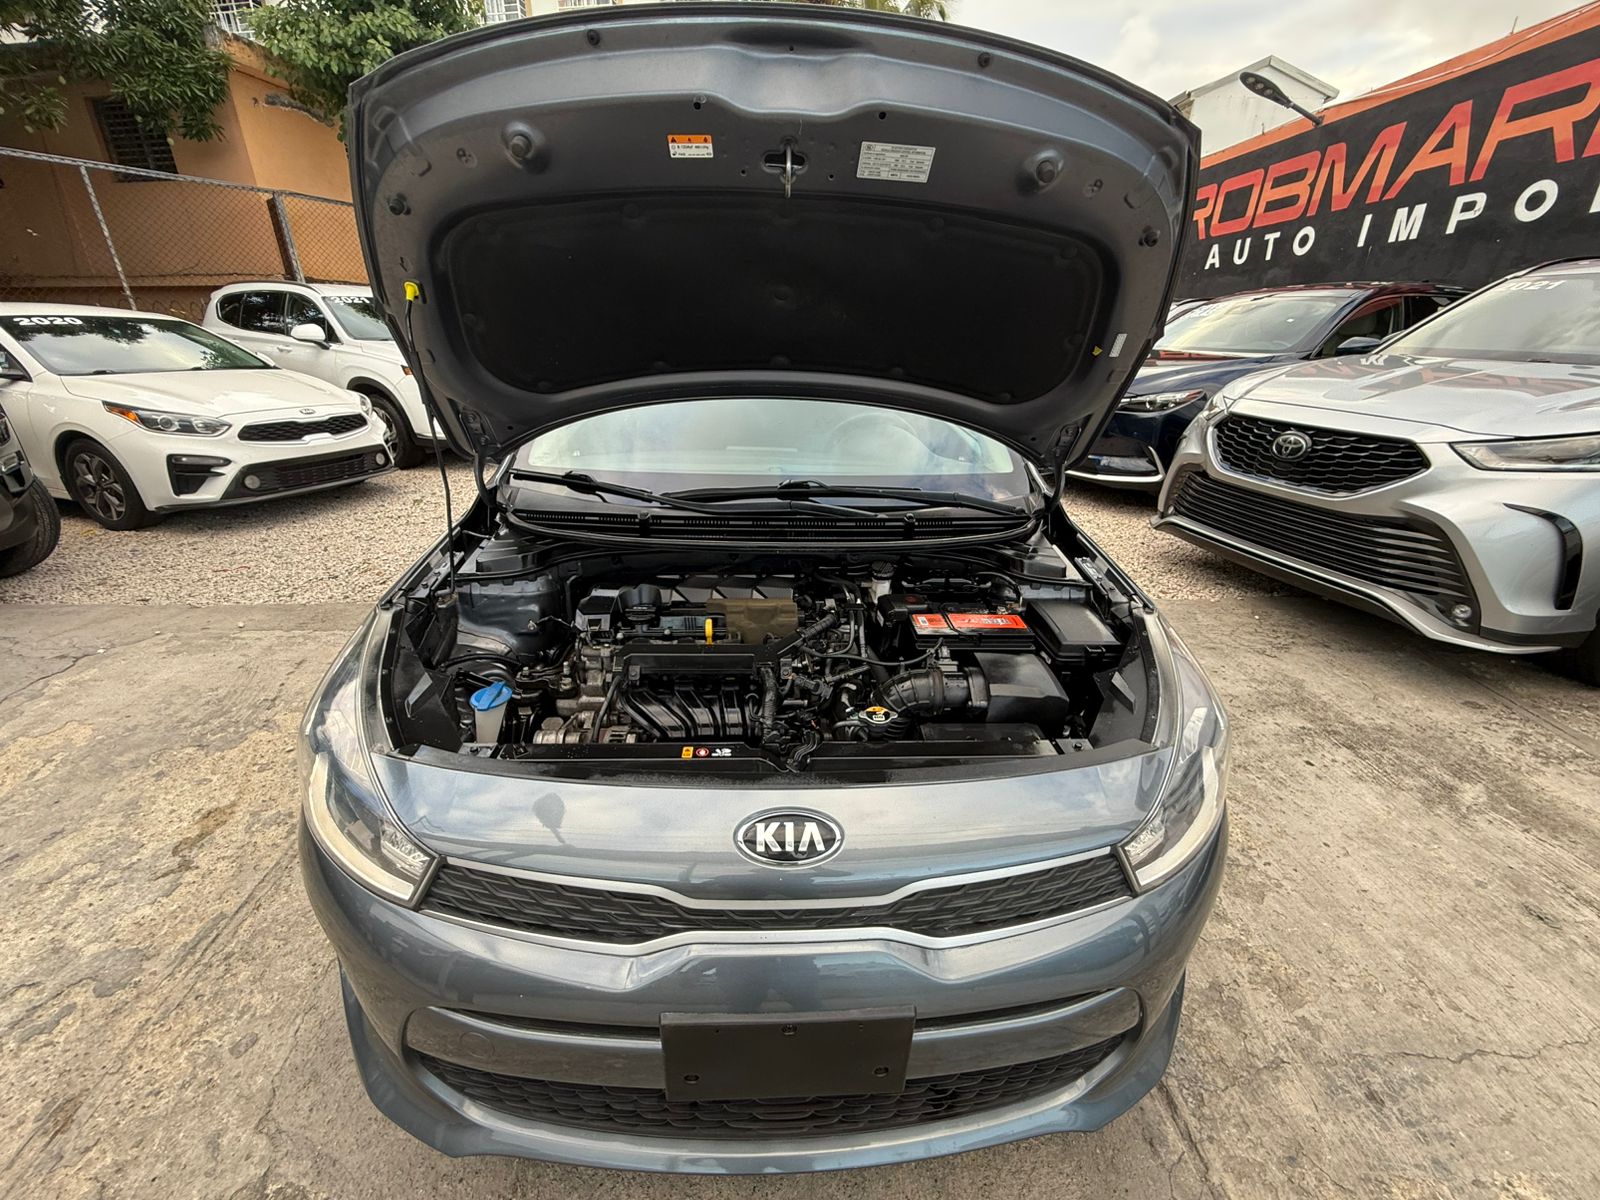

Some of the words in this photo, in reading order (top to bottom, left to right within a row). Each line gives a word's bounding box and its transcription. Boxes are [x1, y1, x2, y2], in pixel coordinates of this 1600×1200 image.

[1193, 58, 1600, 240] ROBMAR
[1204, 226, 1315, 269] AUTO
[1357, 178, 1600, 248] IMPO
[330, 296, 370, 304] 2021
[13, 317, 83, 325] 2020
[755, 821, 826, 852] KIA
